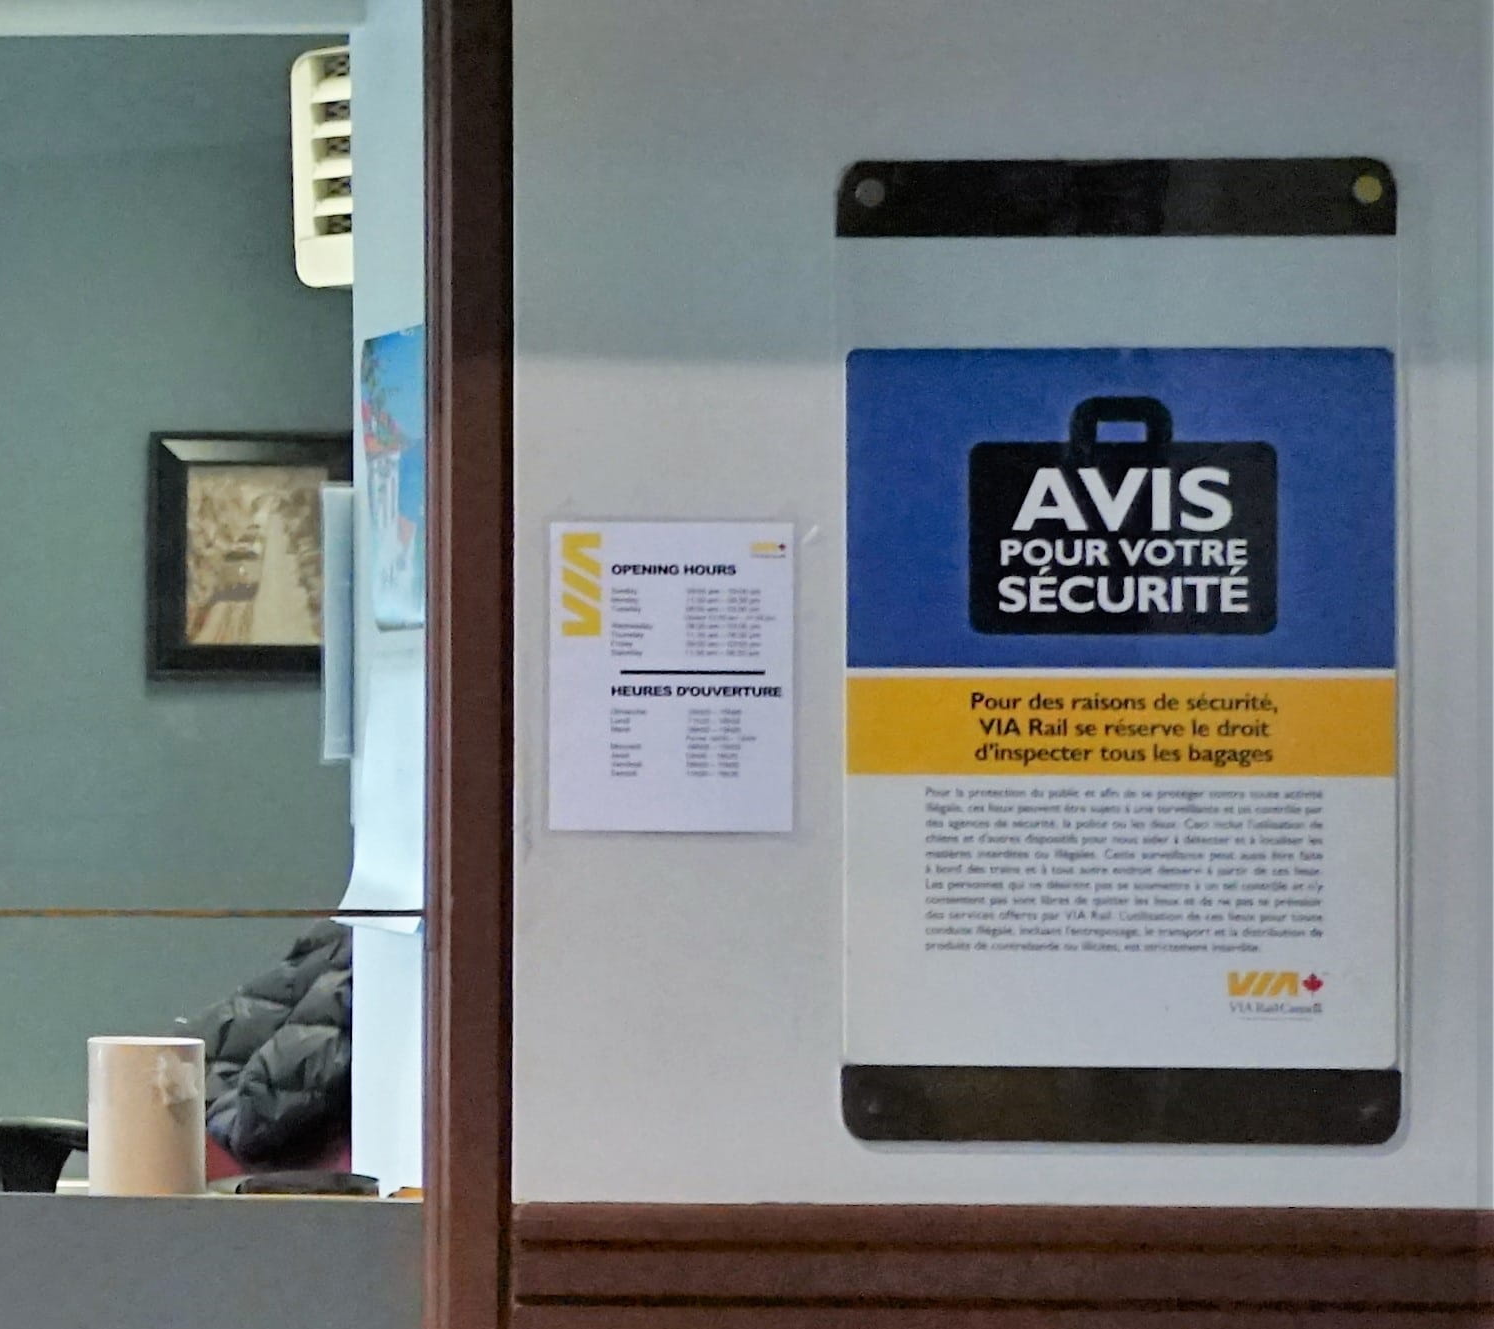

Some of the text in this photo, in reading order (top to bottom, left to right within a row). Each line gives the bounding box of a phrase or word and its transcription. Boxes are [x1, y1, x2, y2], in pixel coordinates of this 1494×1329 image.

[1011, 466, 1234, 532] AVIS
[1000, 537, 1250, 568] POUR VOTRE
[611, 563, 737, 576] OPENING HOURS
[997, 566, 1251, 614] SÉCURITÉ
[611, 685, 783, 698] HEURES D'OUVERTURE
[970, 690, 1279, 716] Pour des raisons de sécurité,
[978, 717, 1271, 738] VIA Rail se réserve le droit
[974, 742, 1274, 768] d'inspecter tous les bagages
[1228, 970, 1299, 997] VIA
